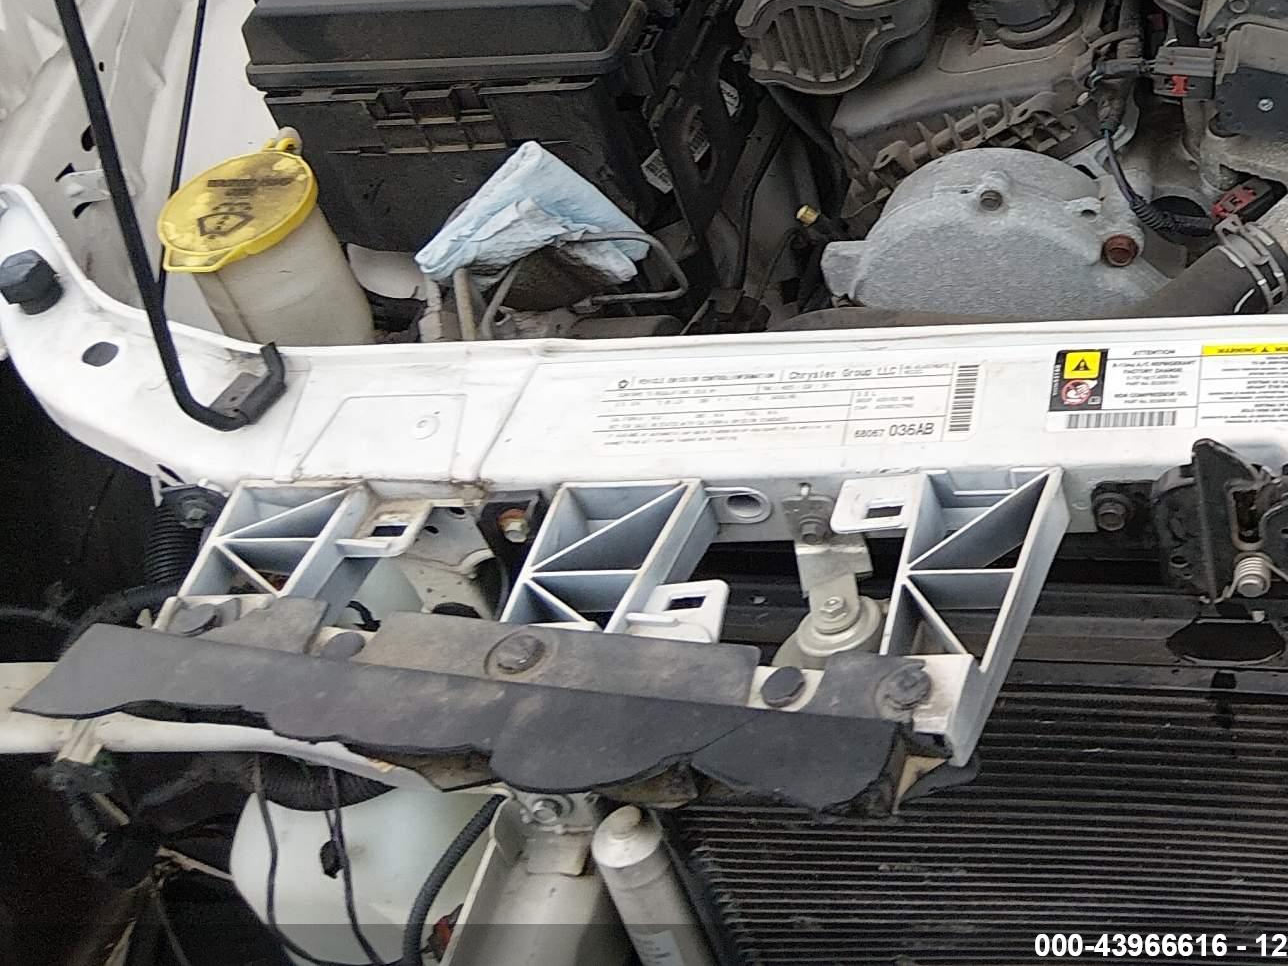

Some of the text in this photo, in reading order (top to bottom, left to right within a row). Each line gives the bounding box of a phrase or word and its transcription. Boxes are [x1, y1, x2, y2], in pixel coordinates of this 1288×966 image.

[788, 370, 836, 382] Chrysler
[843, 368, 872, 378] Group
[877, 366, 898, 375] LLC
[889, 422, 936, 437] 036AB
